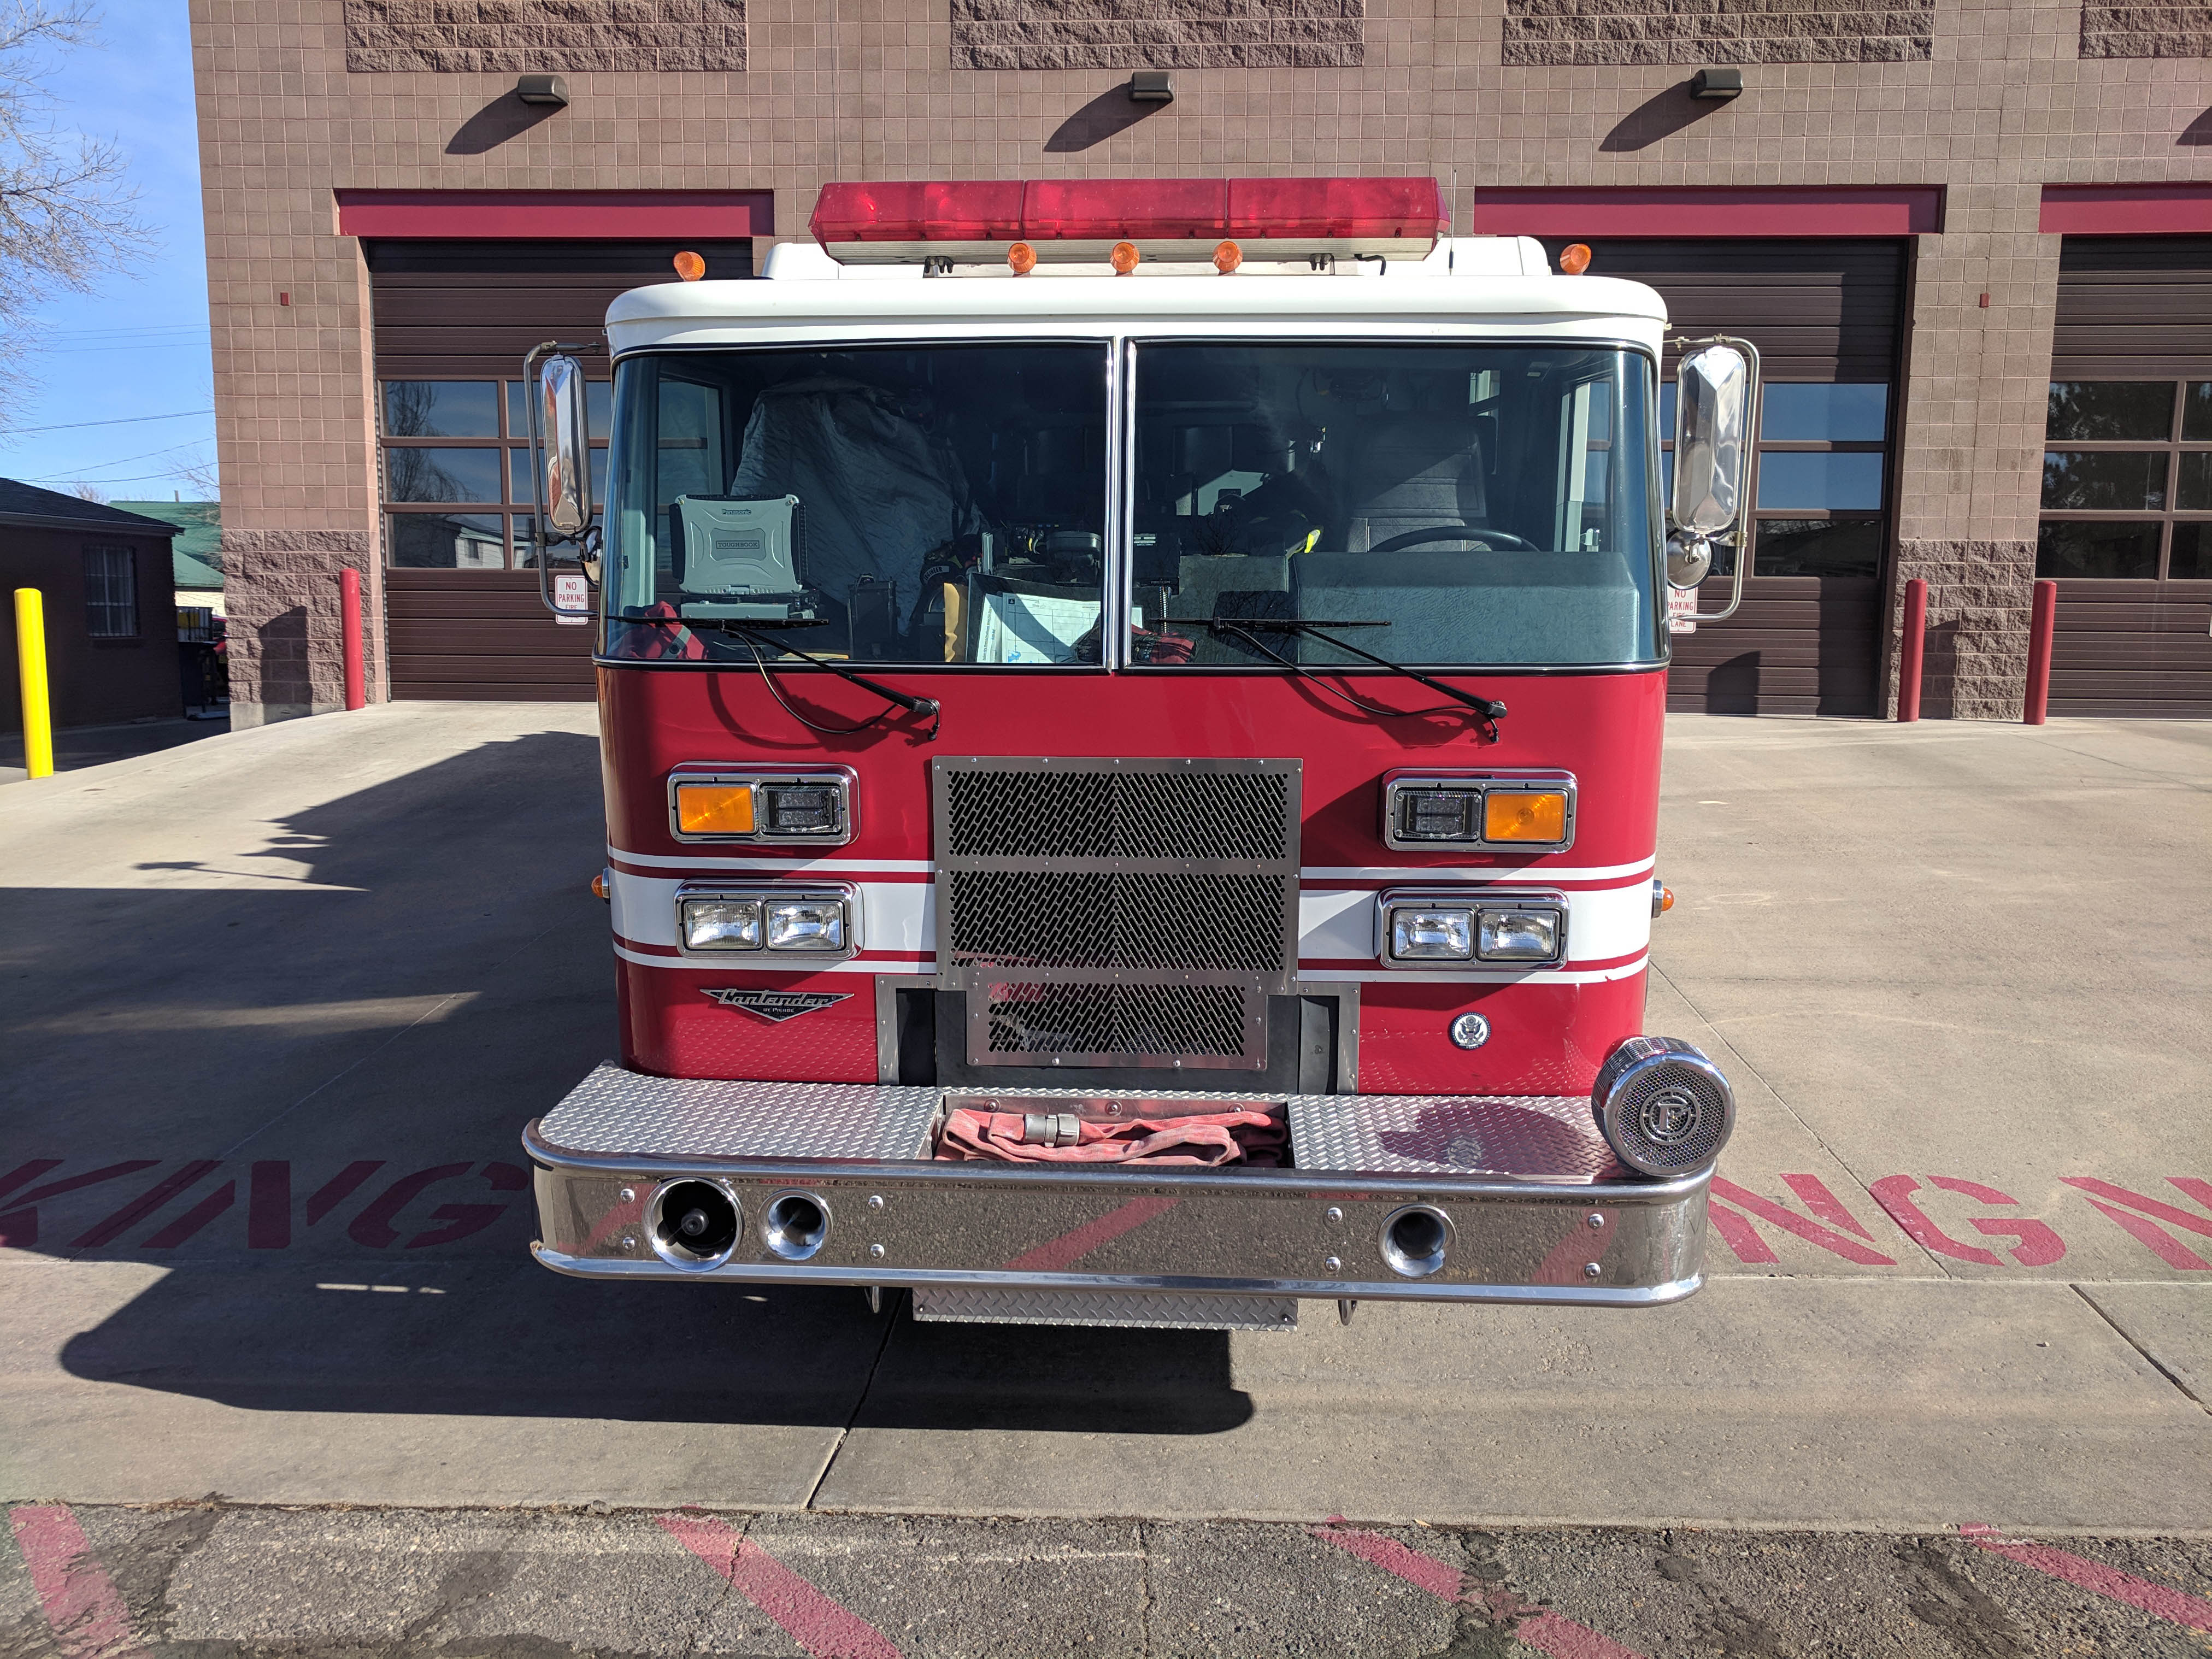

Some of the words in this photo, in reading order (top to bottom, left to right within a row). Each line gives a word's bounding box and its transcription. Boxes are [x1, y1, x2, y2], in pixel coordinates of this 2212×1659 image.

[566, 581, 577, 591] NO
[558, 593, 585, 603] PARKING
[1675, 589, 1686, 598] NO
[719, 988, 832, 1007] Contender
